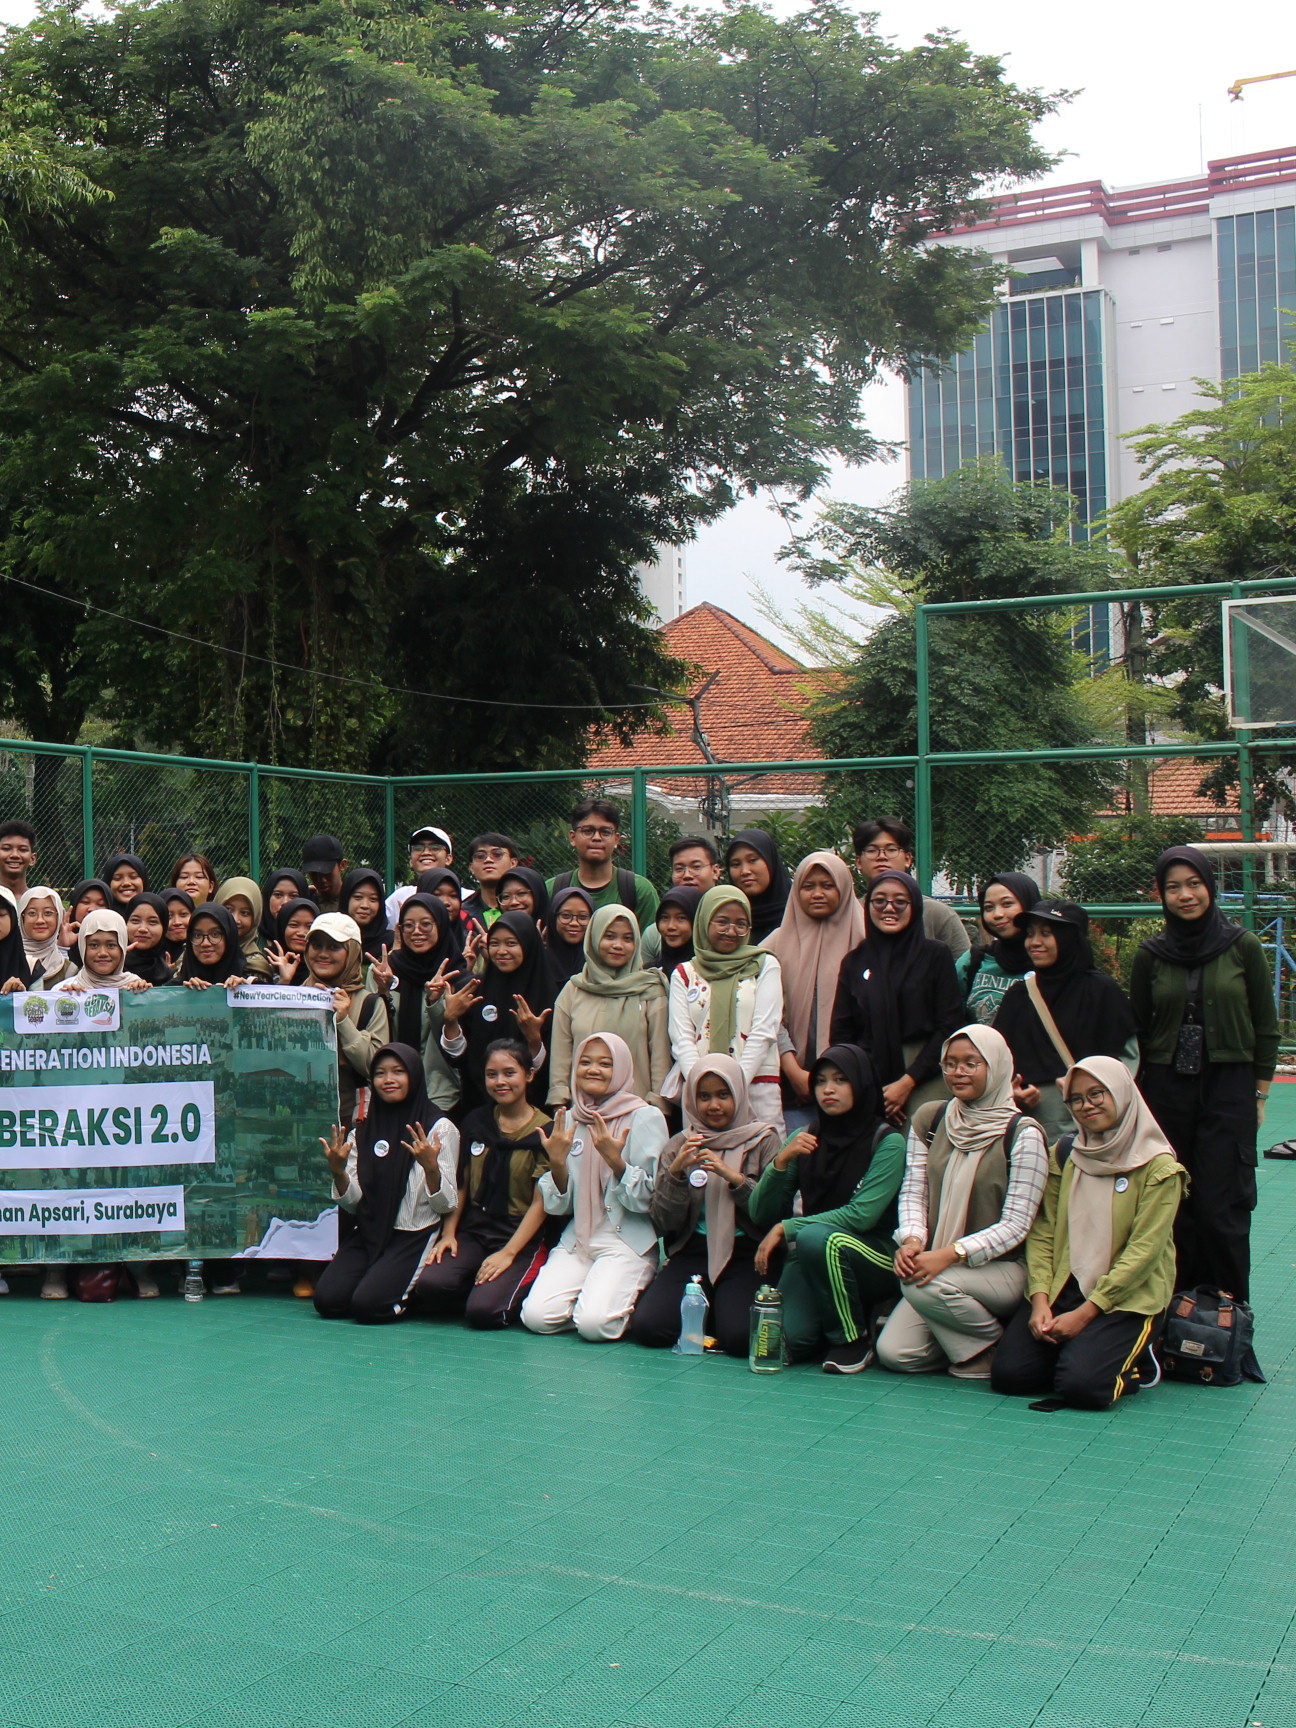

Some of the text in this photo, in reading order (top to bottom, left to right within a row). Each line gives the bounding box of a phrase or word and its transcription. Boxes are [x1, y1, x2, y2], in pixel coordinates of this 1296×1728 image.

[234, 990, 331, 1003] #NewYearCleanUpAction
[110, 1044, 212, 1068] INDONESIA
[150, 1102, 201, 1144] 2.0
[29, 1200, 90, 1228] Apsari,
[94, 1200, 177, 1225] Surabaya
